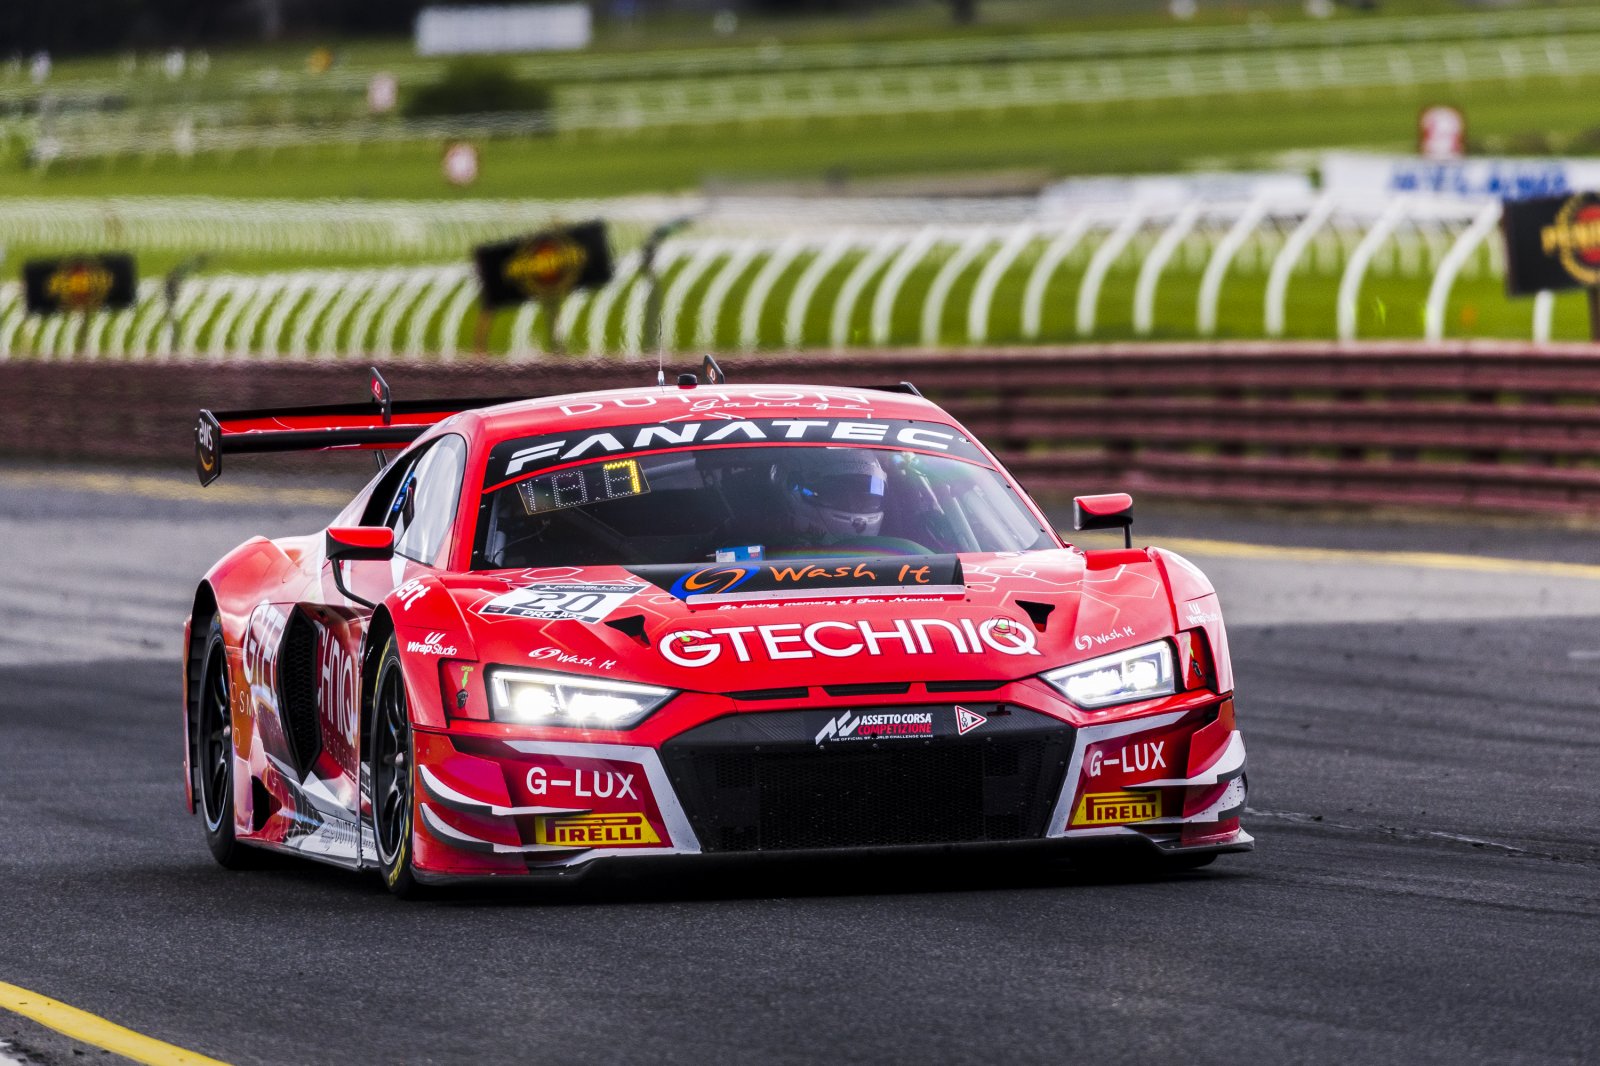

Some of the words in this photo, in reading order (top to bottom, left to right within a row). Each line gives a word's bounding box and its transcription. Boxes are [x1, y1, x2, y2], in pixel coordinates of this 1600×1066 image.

[559, 391, 871, 416] DUTTON
[689, 398, 875, 412] Garage
[505, 419, 954, 476] FANATEC
[769, 563, 876, 581] Wash
[898, 564, 930, 583] It
[514, 593, 607, 613] 20
[660, 617, 1042, 667] GTECHNIQ
[1092, 630, 1122, 645] Wash
[1123, 626, 1136, 637] It
[557, 651, 596, 667] Wash
[858, 722, 932, 736] COMPETIZIONE
[860, 713, 902, 726] ASSETTO
[902, 712, 932, 724] CORSA
[1089, 741, 1167, 777] G-LUX
[526, 766, 638, 800] G-LUX
[1086, 793, 1157, 820] PIRELLI
[545, 815, 642, 843] PIRELLI
